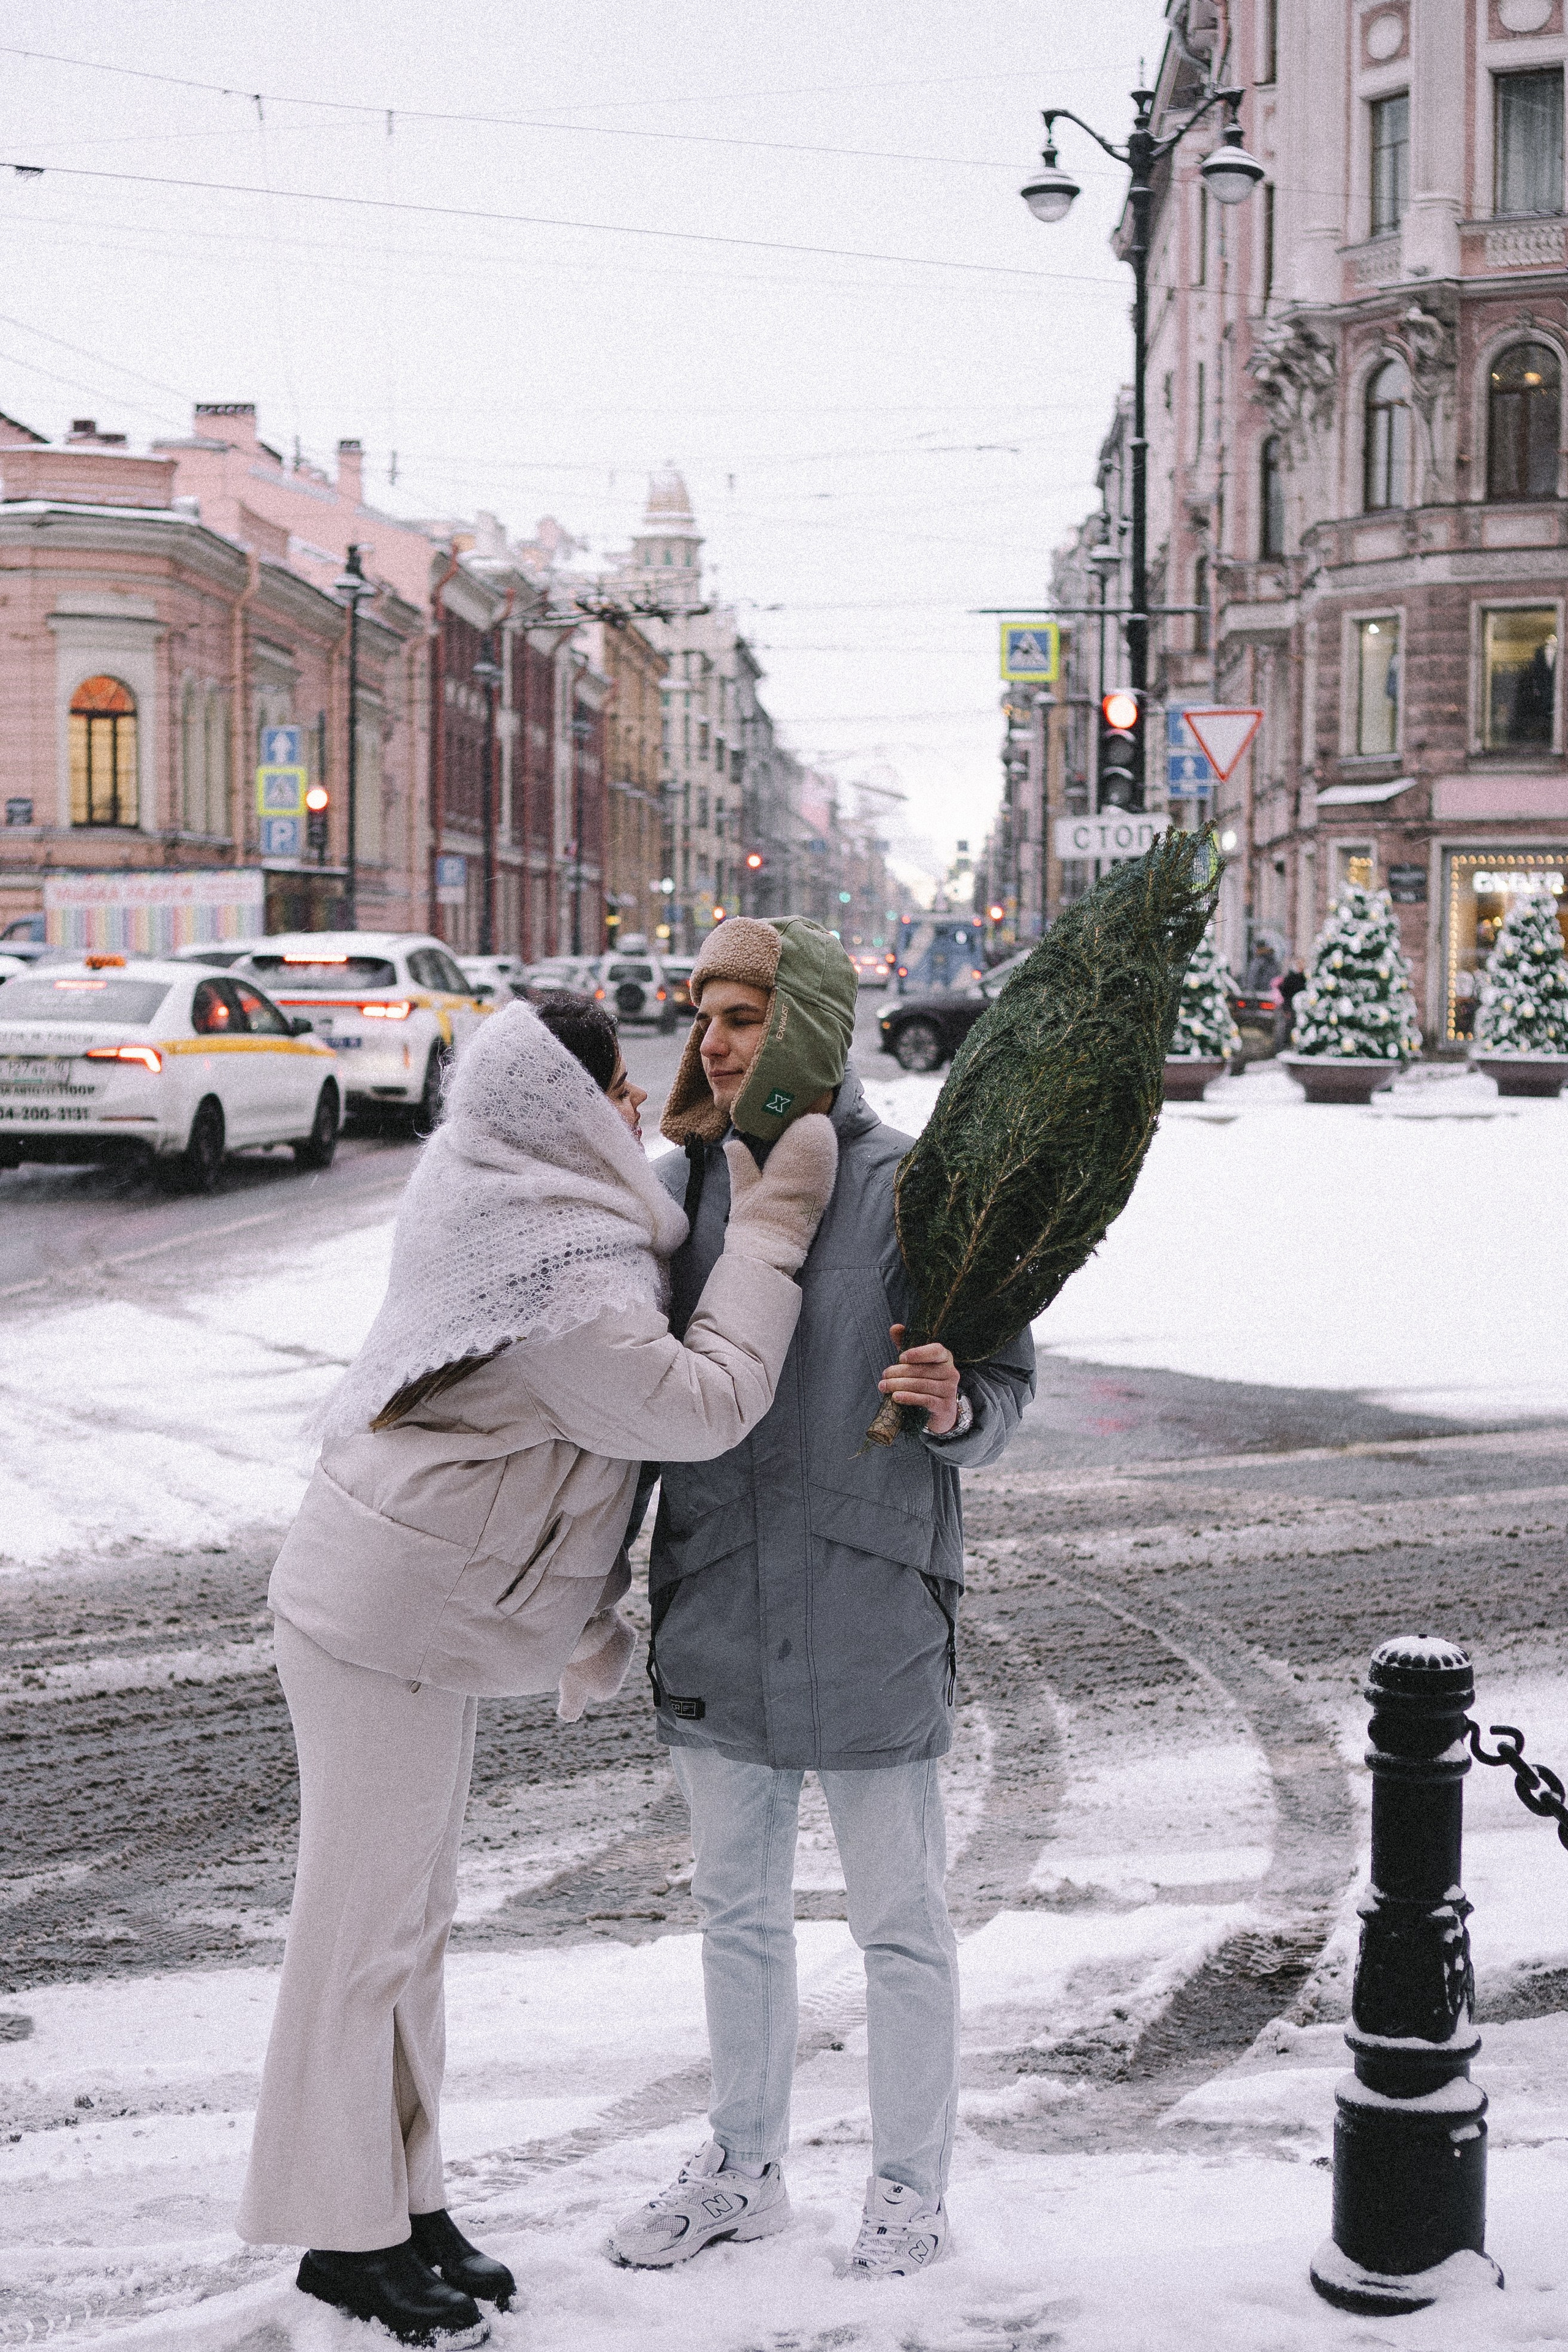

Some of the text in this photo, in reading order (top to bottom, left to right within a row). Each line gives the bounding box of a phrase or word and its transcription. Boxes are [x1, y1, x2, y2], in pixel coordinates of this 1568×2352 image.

[272, 820, 293, 850] P
[1074, 825, 1154, 850] СТОП
[775, 1003, 790, 1041] EXHAUST
[701, 2194, 733, 2218] N
[908, 2239, 929, 2264] N
